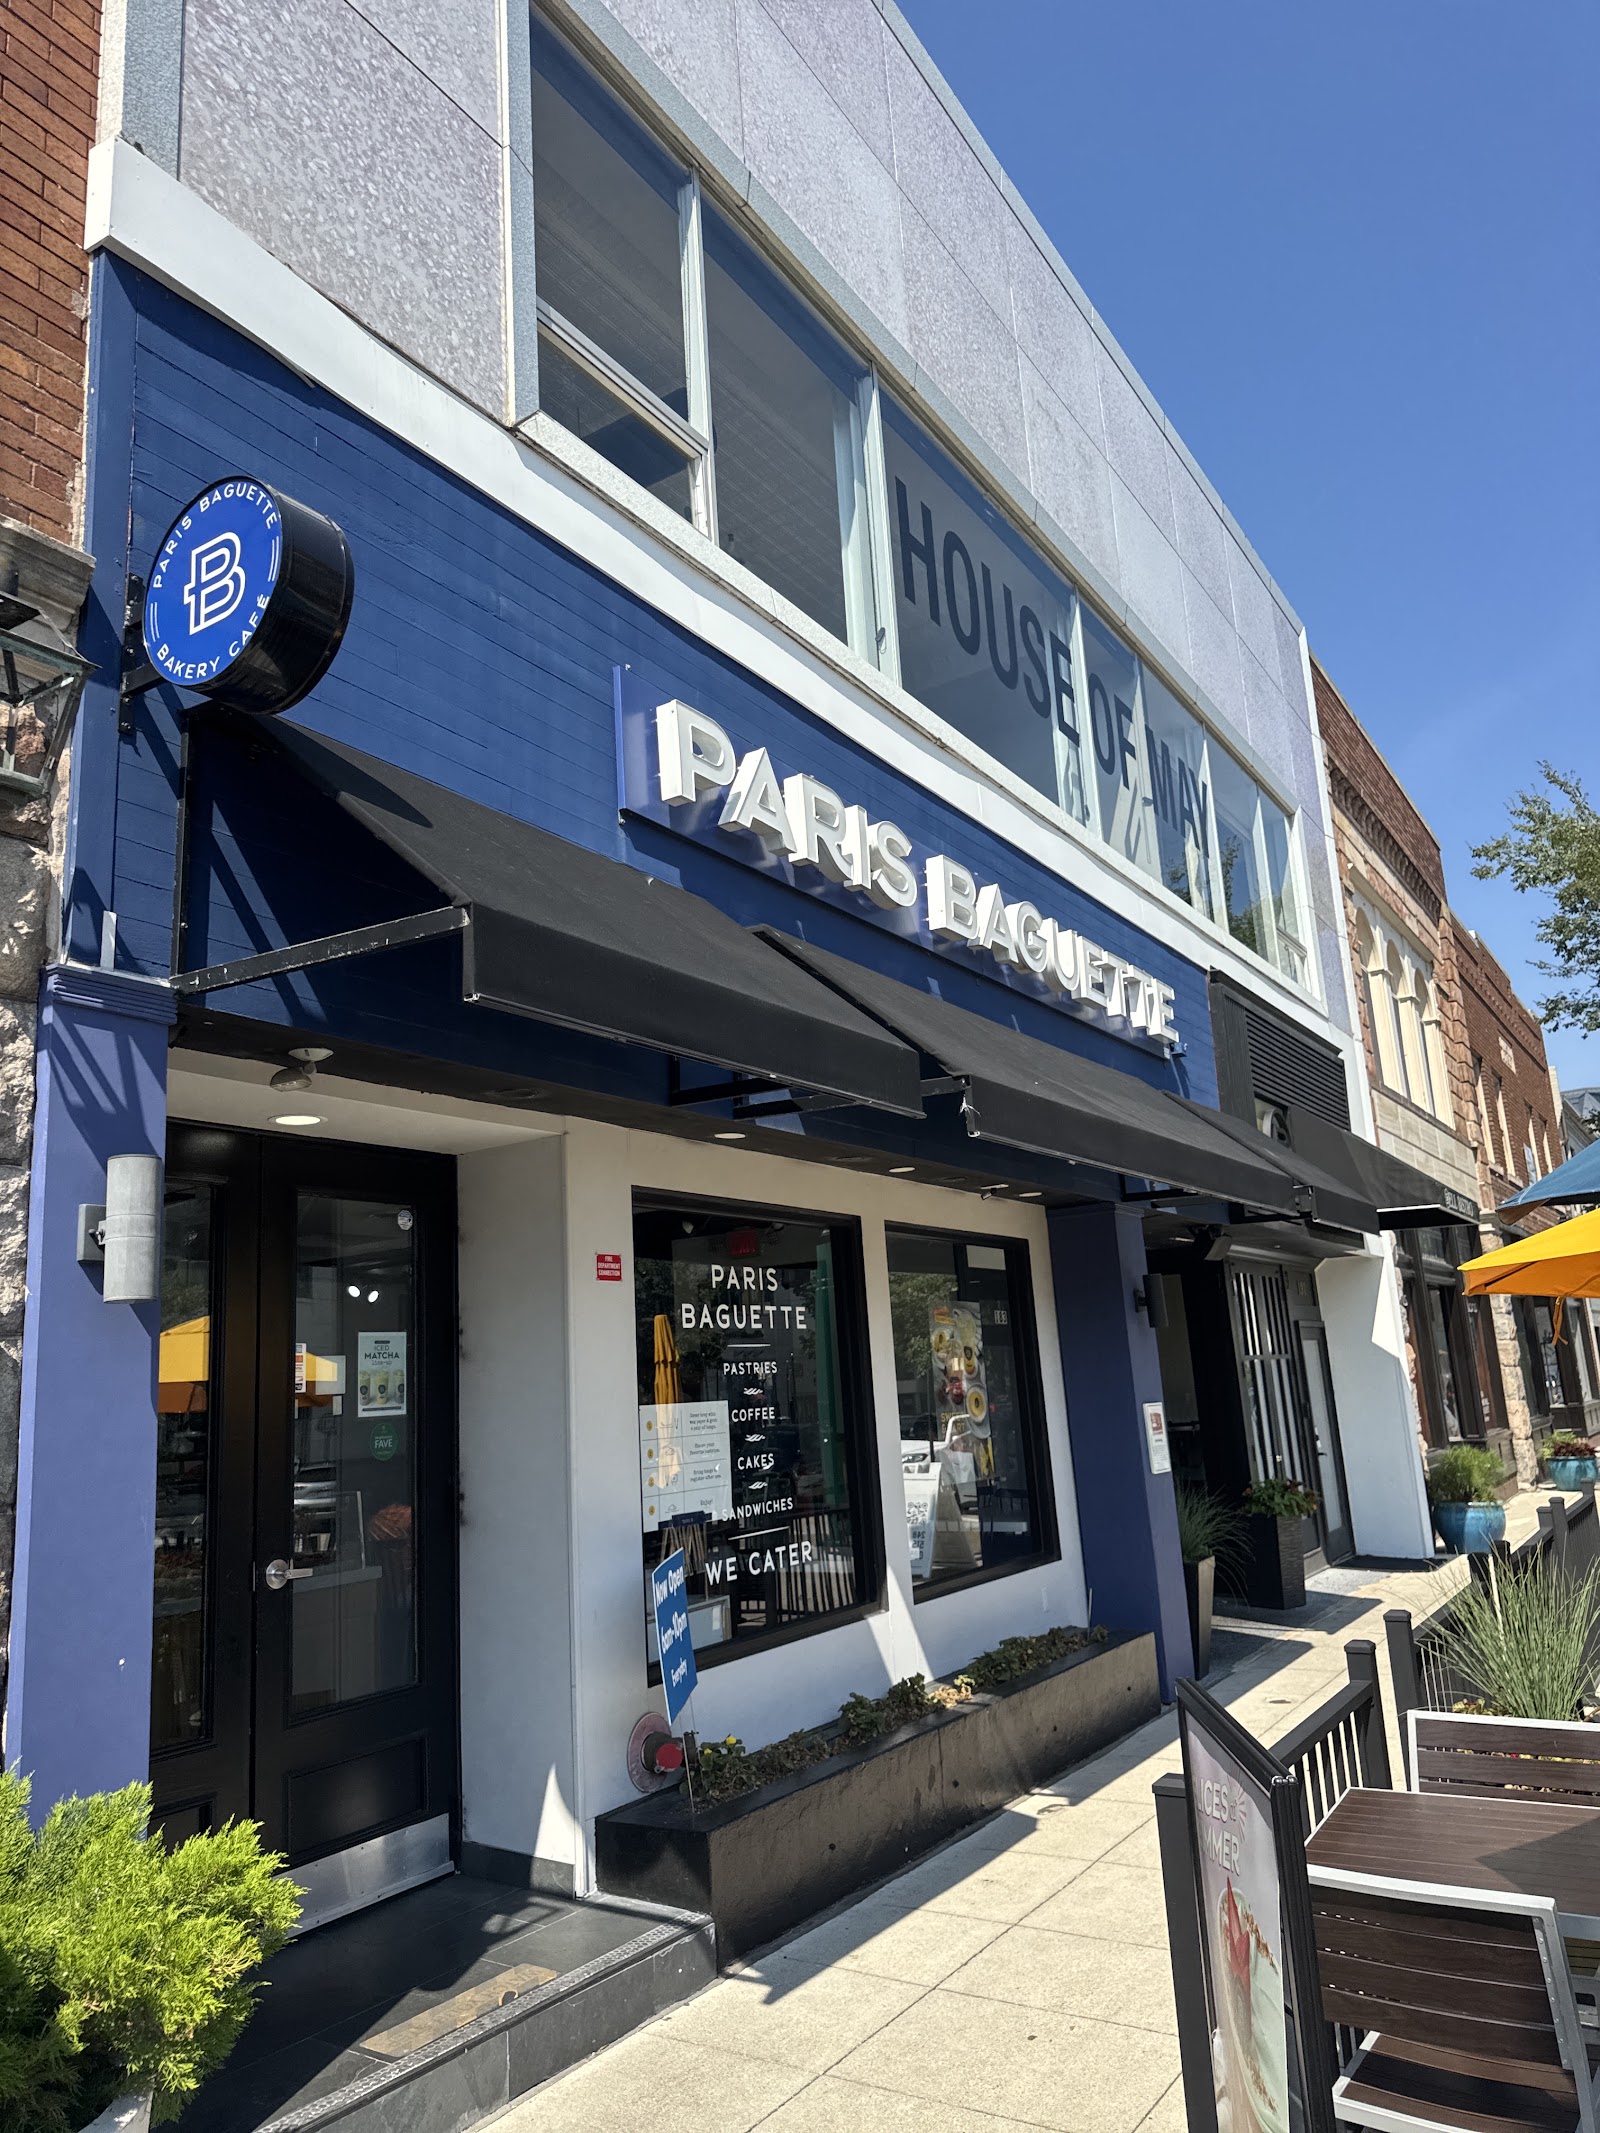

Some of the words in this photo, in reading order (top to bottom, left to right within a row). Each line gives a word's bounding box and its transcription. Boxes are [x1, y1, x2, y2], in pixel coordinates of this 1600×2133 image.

[153, 515, 192, 588] PARIS
[199, 483, 278, 529] BAGUETTE
[157, 643, 220, 679] BAKERY
[228, 593, 270, 657] CAFÉ
[895, 476, 1080, 747] HOUSE
[1088, 673, 1137, 790] OF
[1145, 724, 1210, 859] MAY
[656, 699, 918, 909] PARIS
[926, 854, 1179, 1044] BAGUETTE
[711, 1264, 779, 1291] PARIS
[681, 1303, 807, 1329] BAGUETTE
[364, 1351, 400, 1360] MATCHA
[723, 1361, 778, 1375] PASTRIES
[731, 1406, 775, 1422] COFFEE
[374, 1438, 393, 1448] FAVE
[737, 1453, 775, 1470] CAKES
[721, 1497, 793, 1521] SANDWICHES
[705, 1556, 738, 1585] WE
[749, 1540, 812, 1575] CATER
[654, 1578, 668, 1608] Now
[668, 1565, 685, 1596] Open
